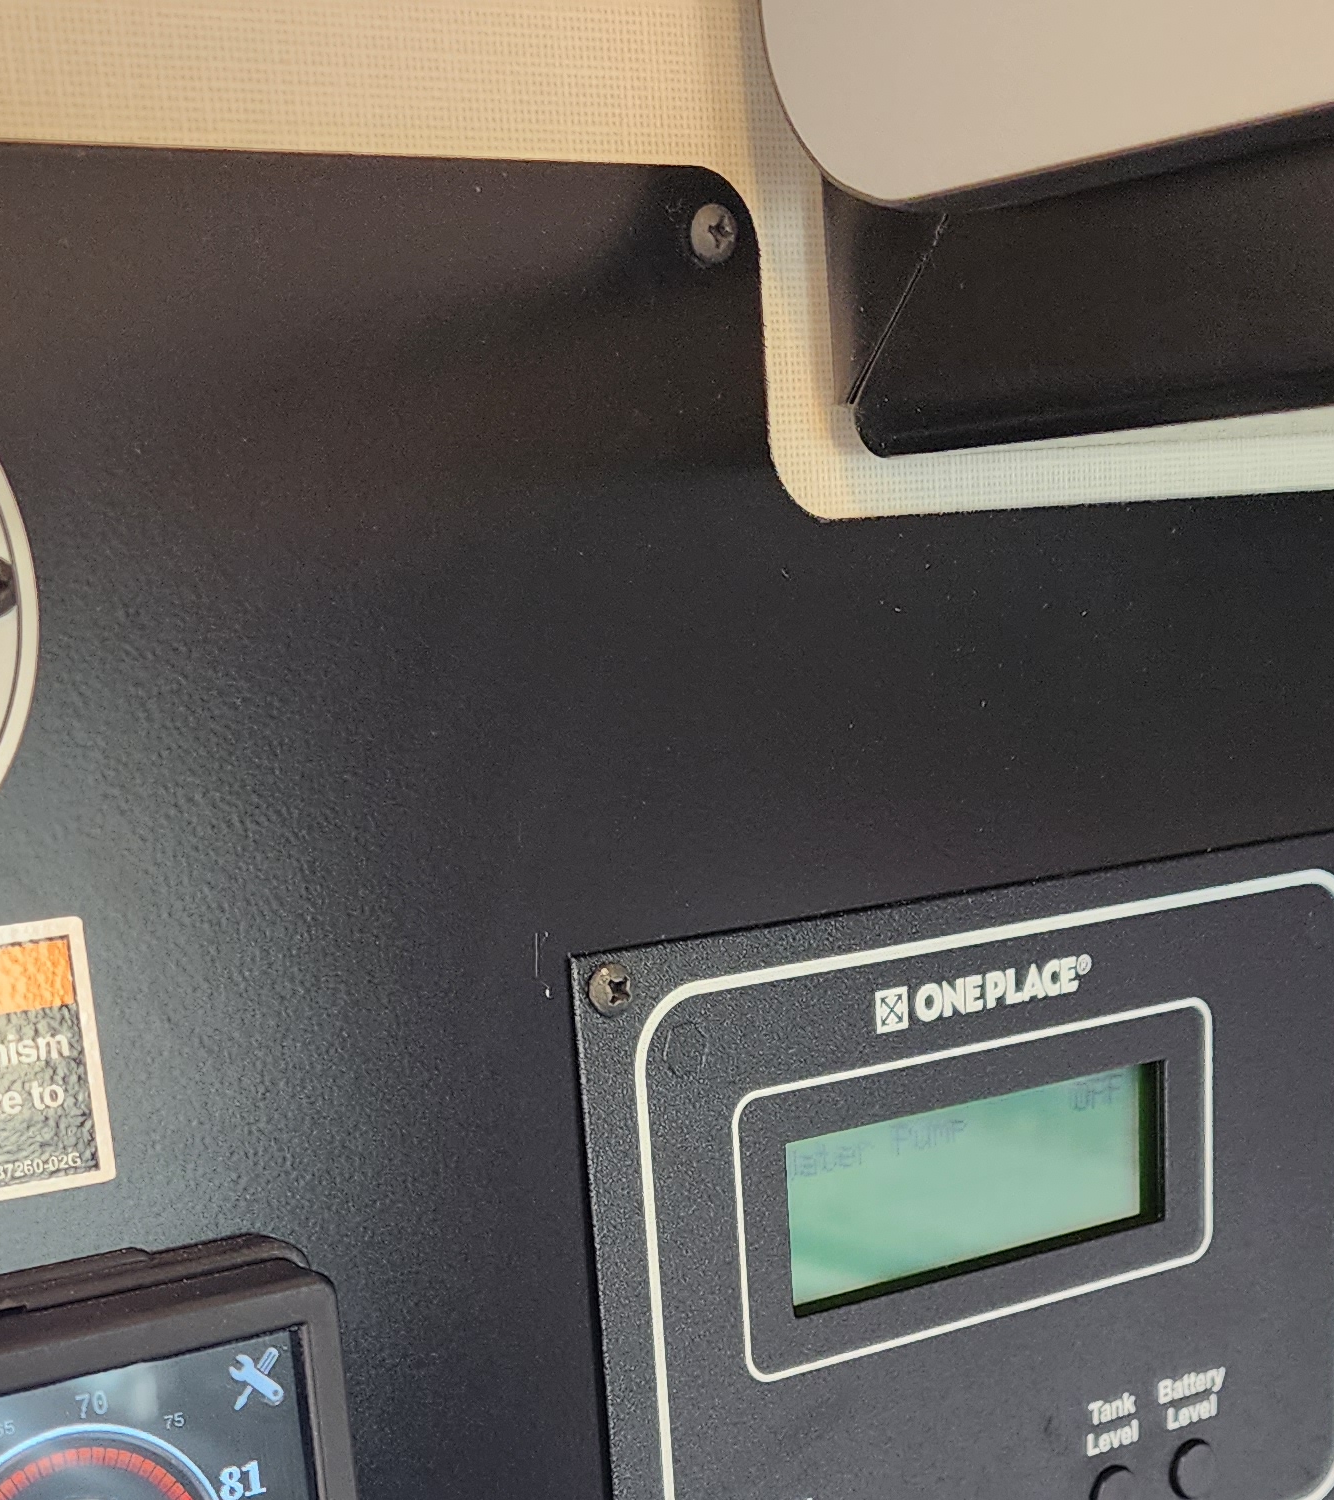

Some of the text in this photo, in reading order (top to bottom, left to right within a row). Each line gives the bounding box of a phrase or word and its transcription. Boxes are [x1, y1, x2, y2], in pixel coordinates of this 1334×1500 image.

[32, 1082, 66, 1111] to
[1157, 1366, 1226, 1405] Battery
[75, 1391, 109, 1418] 70
[163, 1412, 185, 1430] 75
[1087, 1392, 1137, 1426] Tank
[1167, 1394, 1218, 1431] Level
[1086, 1420, 1139, 1456] Level
[219, 1460, 266, 1500] 81
